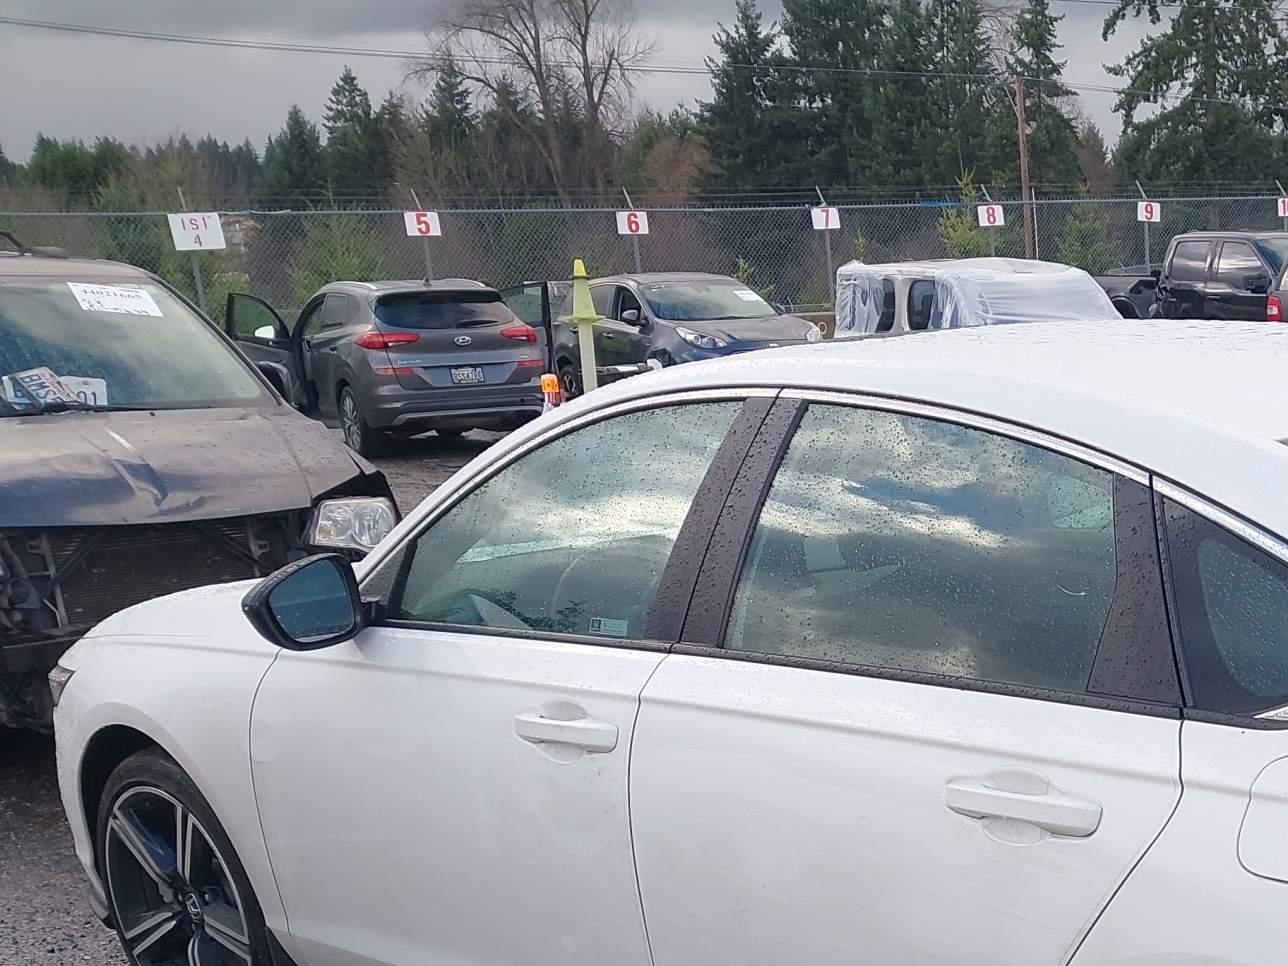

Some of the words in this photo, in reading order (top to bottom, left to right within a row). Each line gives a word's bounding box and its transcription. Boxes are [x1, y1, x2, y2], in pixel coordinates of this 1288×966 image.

[821, 209, 830, 228] 7
[986, 206, 997, 225] 8
[1144, 203, 1154, 220] 9
[415, 212, 431, 235] 5
[627, 212, 640, 233] 6
[194, 233, 203, 247] 4
